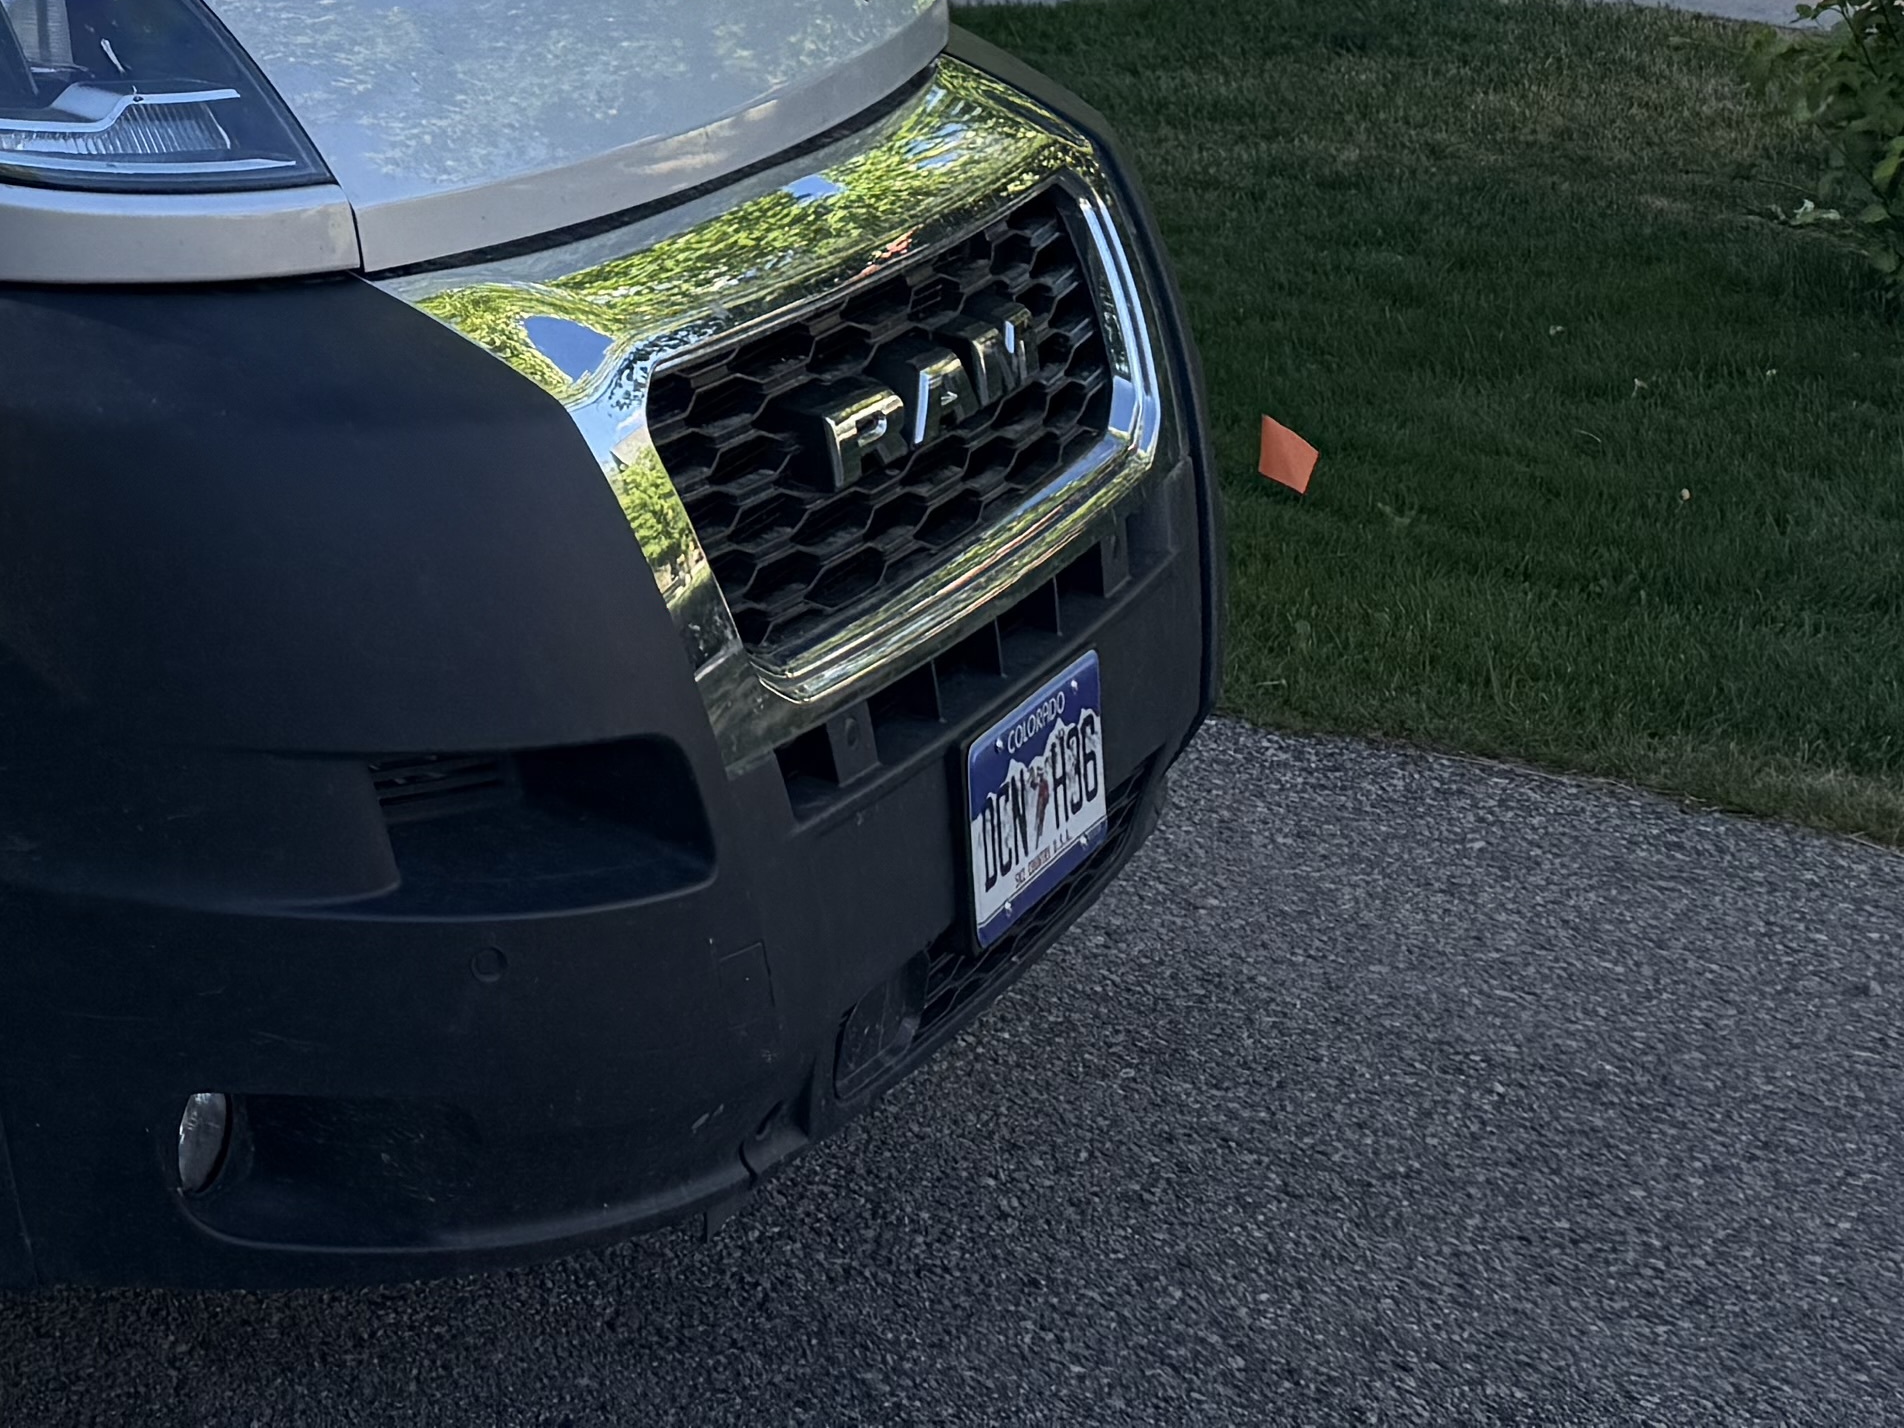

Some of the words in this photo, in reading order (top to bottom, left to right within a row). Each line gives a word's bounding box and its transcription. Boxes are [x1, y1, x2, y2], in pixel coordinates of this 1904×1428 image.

[824, 307, 1041, 492] RAM
[1007, 690, 1066, 755] COLORADO
[981, 767, 1030, 893] DCN
